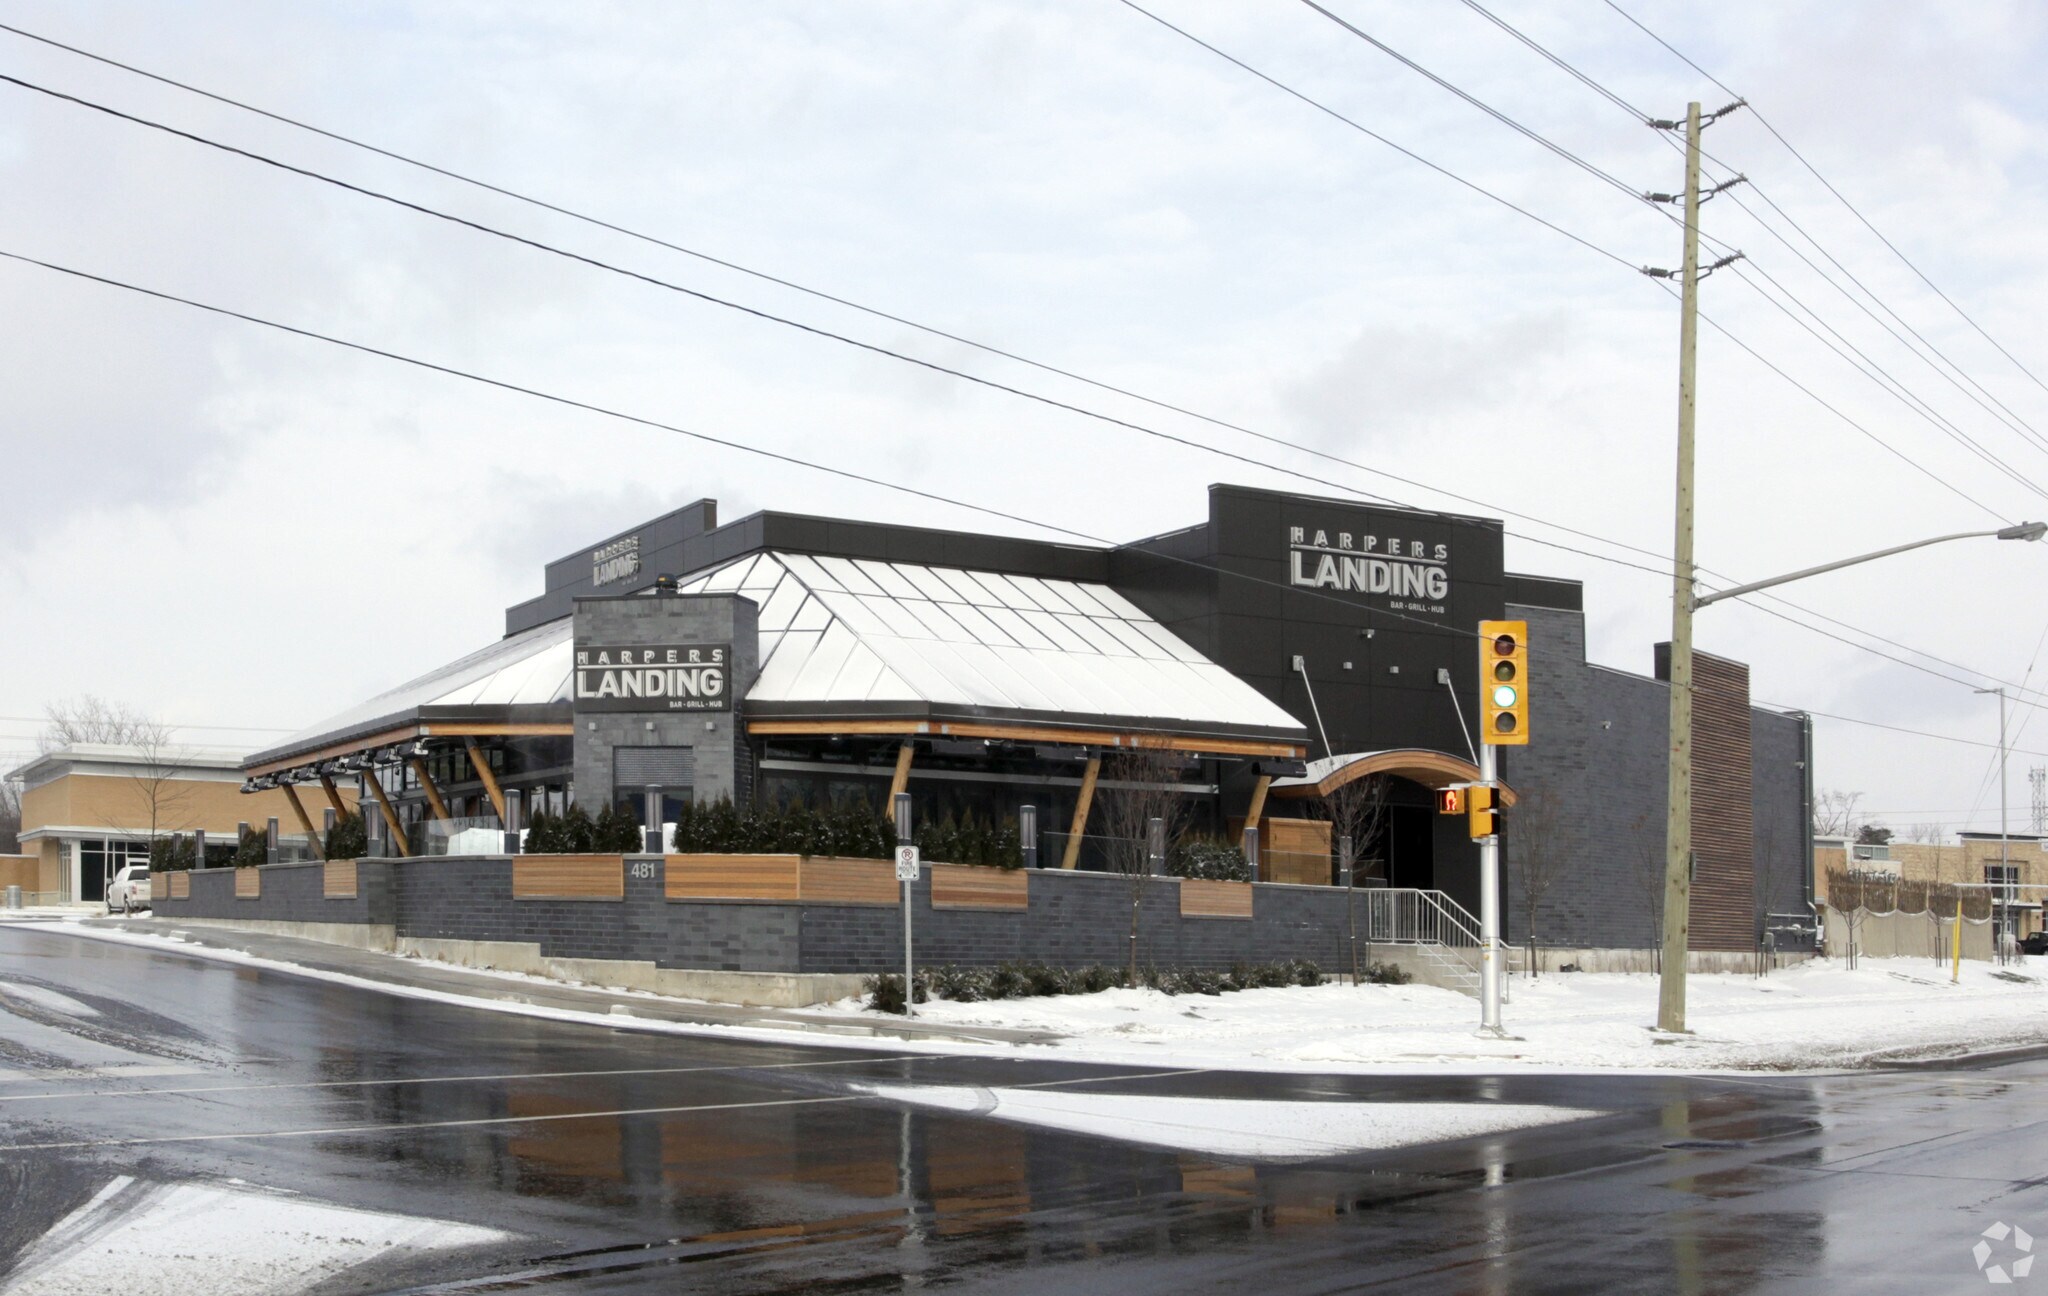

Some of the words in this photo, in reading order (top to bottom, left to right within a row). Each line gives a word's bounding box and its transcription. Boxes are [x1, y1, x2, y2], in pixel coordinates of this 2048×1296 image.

[1290, 526, 1447, 560] HARPERS
[593, 552, 639, 587] LANDING
[1290, 551, 1448, 600] LANDING
[1390, 601, 1404, 609] BAR
[1408, 603, 1427, 612] GRILL
[1431, 605, 1445, 614] HUB
[577, 649, 723, 665] HARPERS
[577, 669, 723, 698] LANDING
[631, 863, 655, 878] 481
